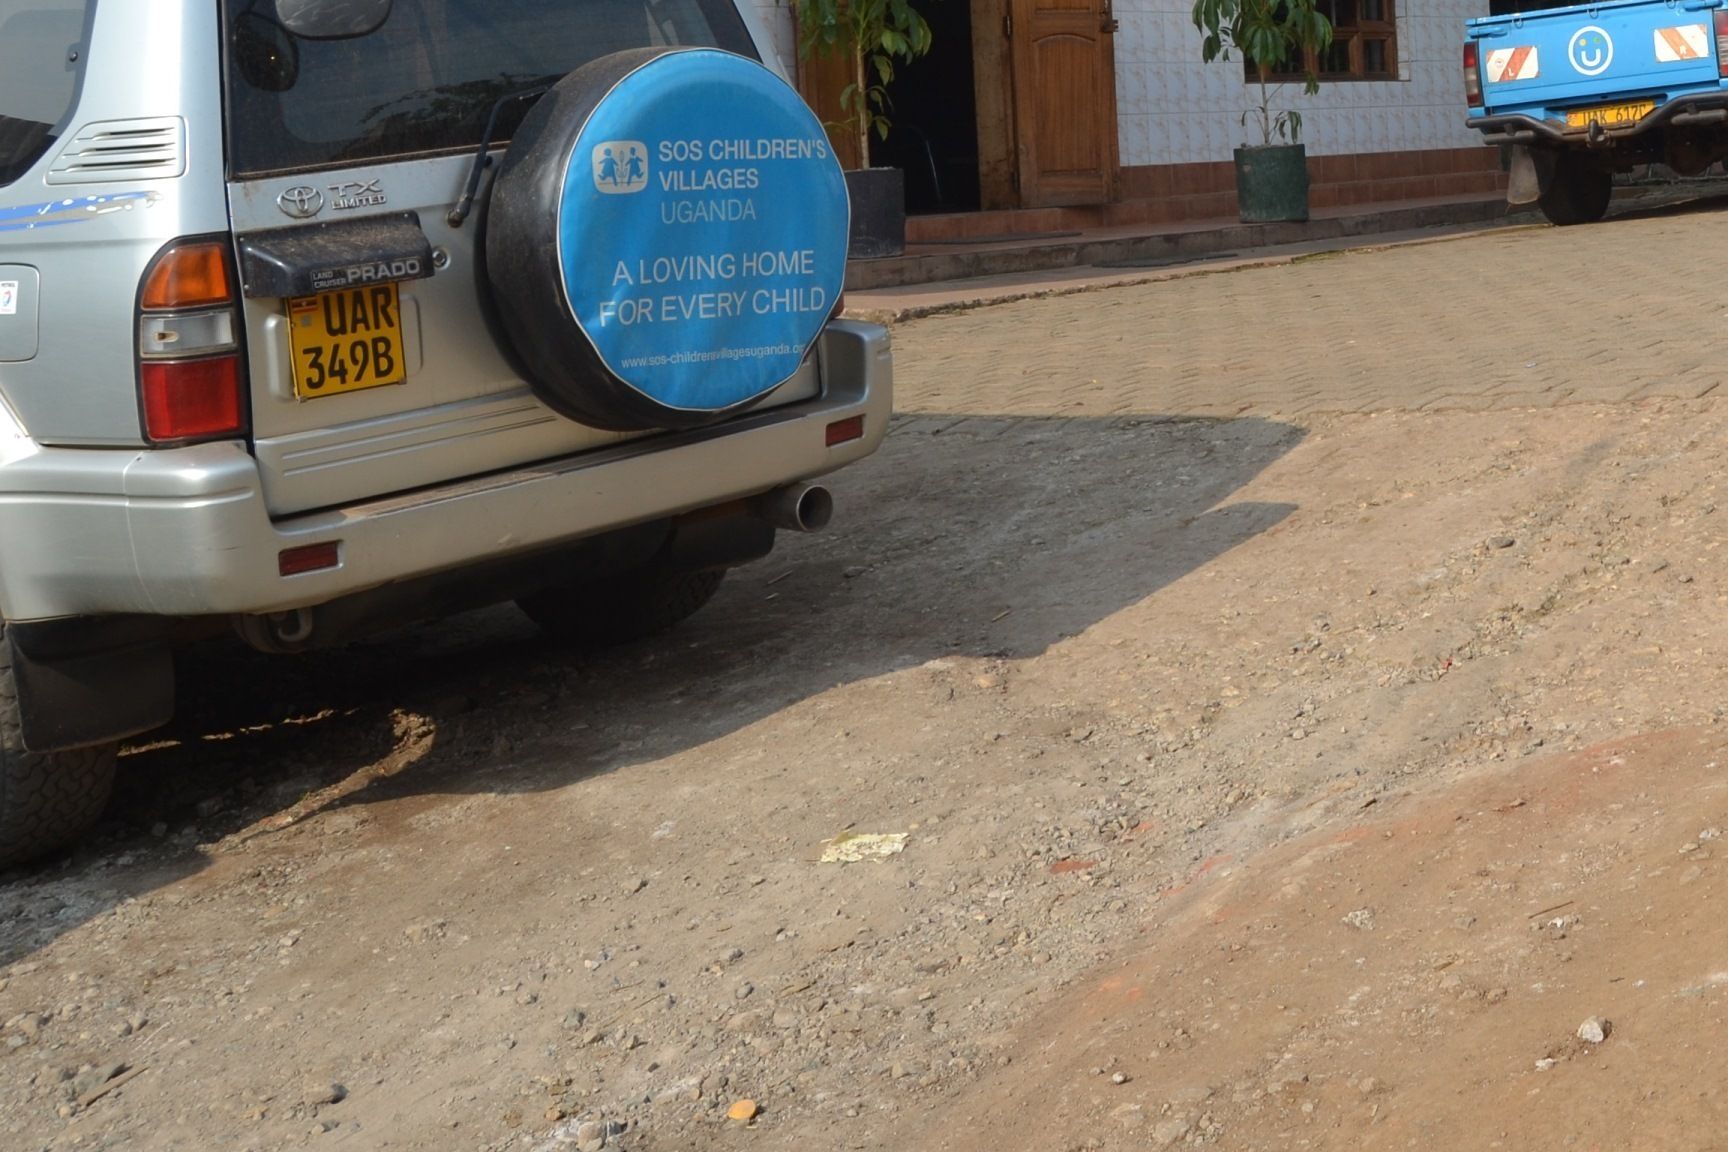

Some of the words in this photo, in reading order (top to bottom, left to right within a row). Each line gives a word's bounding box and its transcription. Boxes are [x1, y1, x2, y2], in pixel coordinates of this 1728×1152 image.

[658, 140, 703, 162] SOS
[708, 139, 827, 161] CHILDREN'S
[327, 178, 382, 197] TX
[658, 168, 759, 192] VILLAGES
[330, 194, 387, 210] LIMITED
[660, 199, 756, 224] UGANDA
[312, 270, 334, 280] LAND
[346, 259, 421, 282] PRADO
[612, 261, 634, 286] A
[639, 253, 736, 285] LOVING
[742, 250, 814, 277] HOME
[313, 277, 347, 289] CRUISER
[322, 286, 395, 337] UAR
[600, 299, 653, 327] FOR
[661, 291, 747, 322] EVERY
[752, 287, 826, 314] CHILD
[302, 336, 394, 390] 349B
